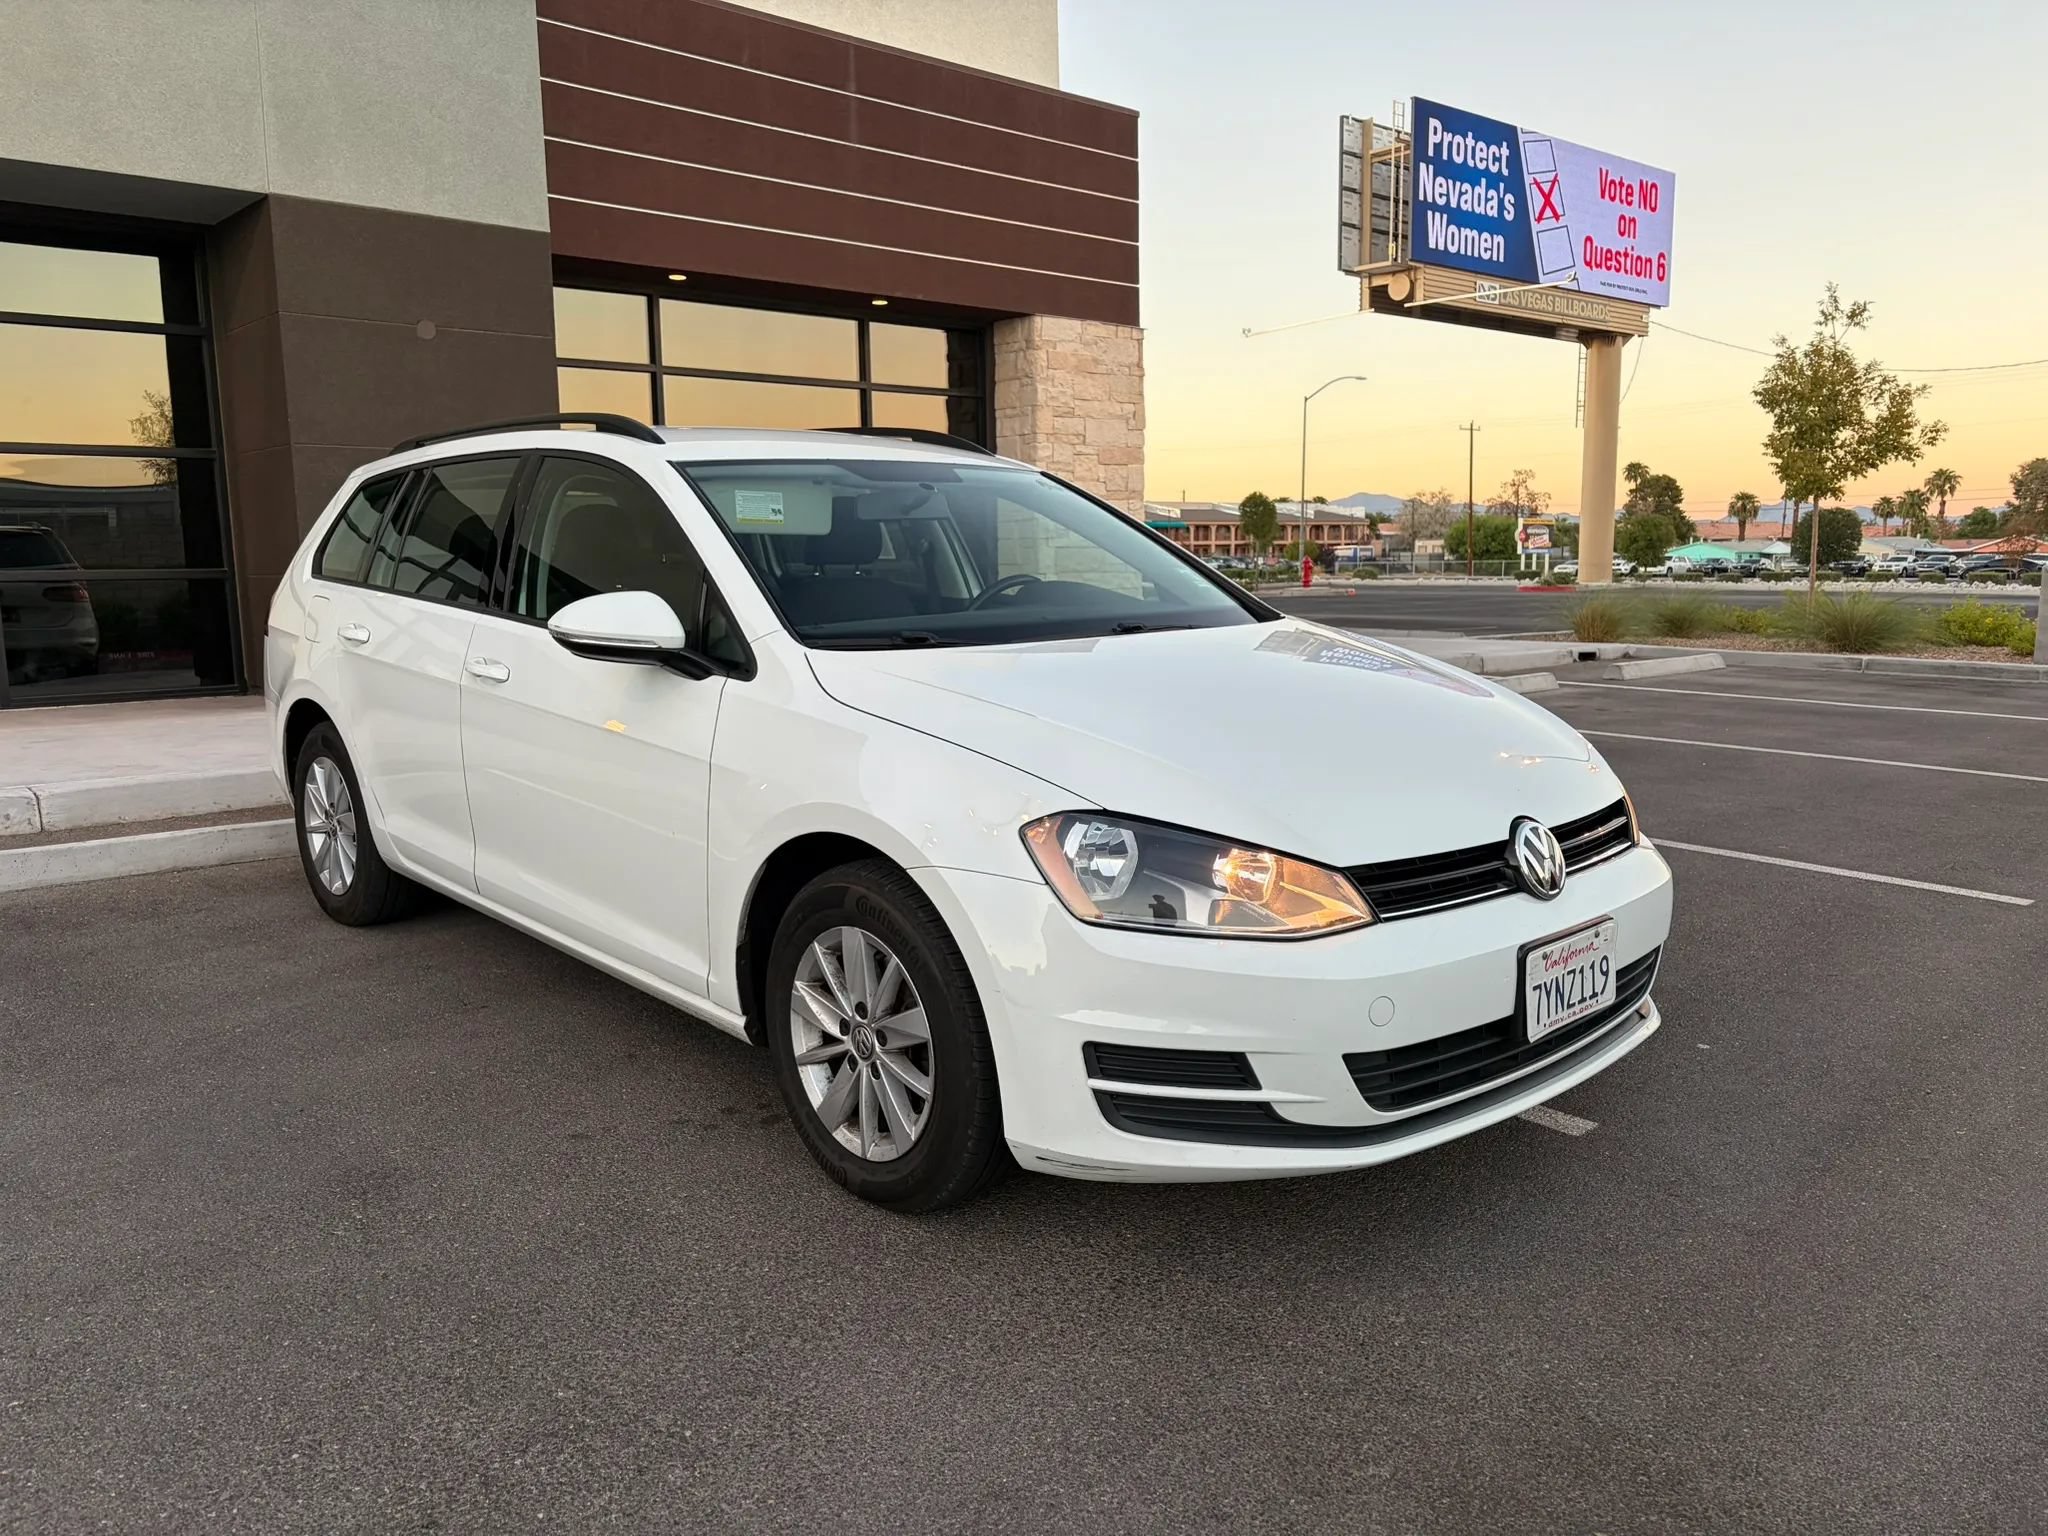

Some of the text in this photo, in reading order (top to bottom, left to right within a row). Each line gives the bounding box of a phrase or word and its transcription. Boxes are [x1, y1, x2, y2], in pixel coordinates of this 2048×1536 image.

[1427, 117, 1510, 176] Protect
[1418, 162, 1515, 222] Nevada's
[1599, 167, 1659, 213] Vote NO
[1427, 210, 1505, 263] Women
[1617, 213, 1637, 239] on
[1583, 235, 1667, 282] Question 6
[1500, 287, 1520, 305] LAS
[1520, 291, 1553, 312] VEGAS
[1555, 296, 1610, 319] BILLBOARDS
[1545, 941, 1599, 972] California
[1532, 955, 1610, 1025] 7YNZ119
